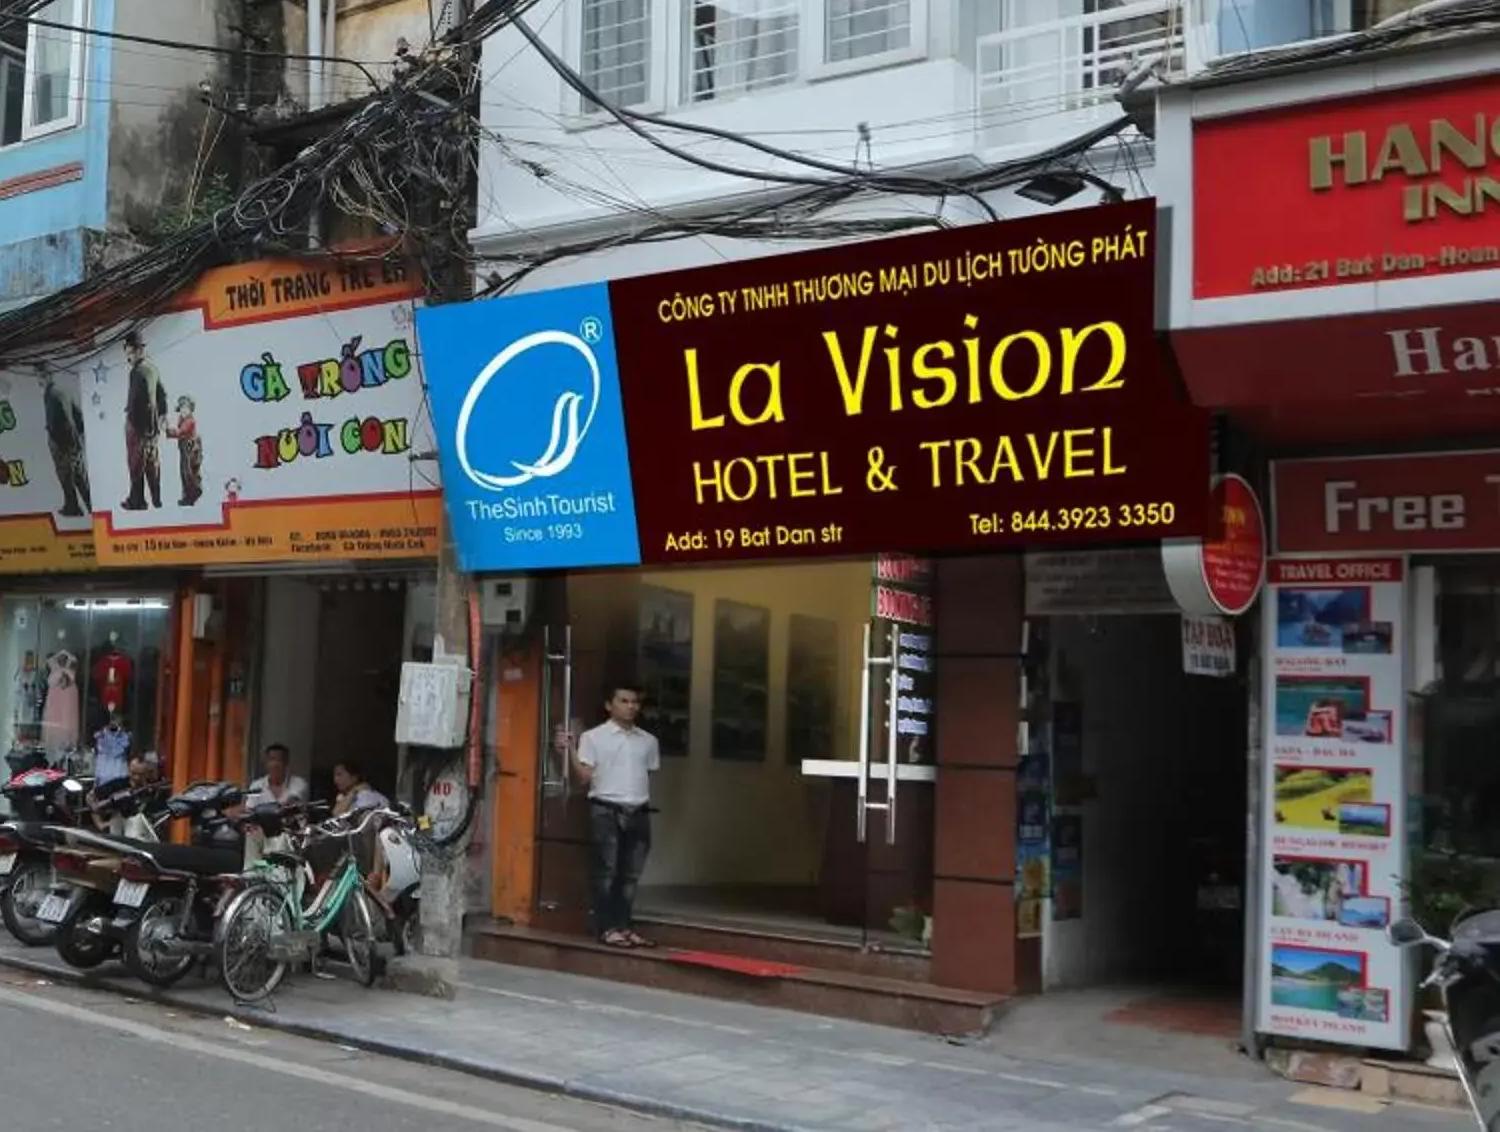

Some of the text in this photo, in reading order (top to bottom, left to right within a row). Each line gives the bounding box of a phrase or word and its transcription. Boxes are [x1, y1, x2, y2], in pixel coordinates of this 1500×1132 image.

[1309, 113, 1500, 189] HAN
[271, 271, 331, 304] TRANG
[658, 292, 714, 323] CÔNG
[718, 290, 737, 314] TY
[742, 283, 788, 311] TNHH
[879, 264, 918, 296] MẠI
[924, 260, 950, 286] DU
[1008, 237, 1085, 275] TƯỜNG
[1092, 224, 1148, 263] PHÁT
[240, 335, 412, 402] GÀ TRỐNG
[684, 313, 1127, 430] La Vision
[1384, 326, 1500, 377] Ha
[340, 416, 412, 455] CON
[692, 427, 1127, 504] HOTEL & TRAVEL
[969, 502, 1175, 535] Tel: 844.3923 3350
[1325, 480, 1465, 534] Free
[504, 523, 583, 544] Since 1993
[665, 525, 843, 552] Add: 19 Bat Dan str
[1280, 562, 1392, 580] TRAVEL OFFICE
